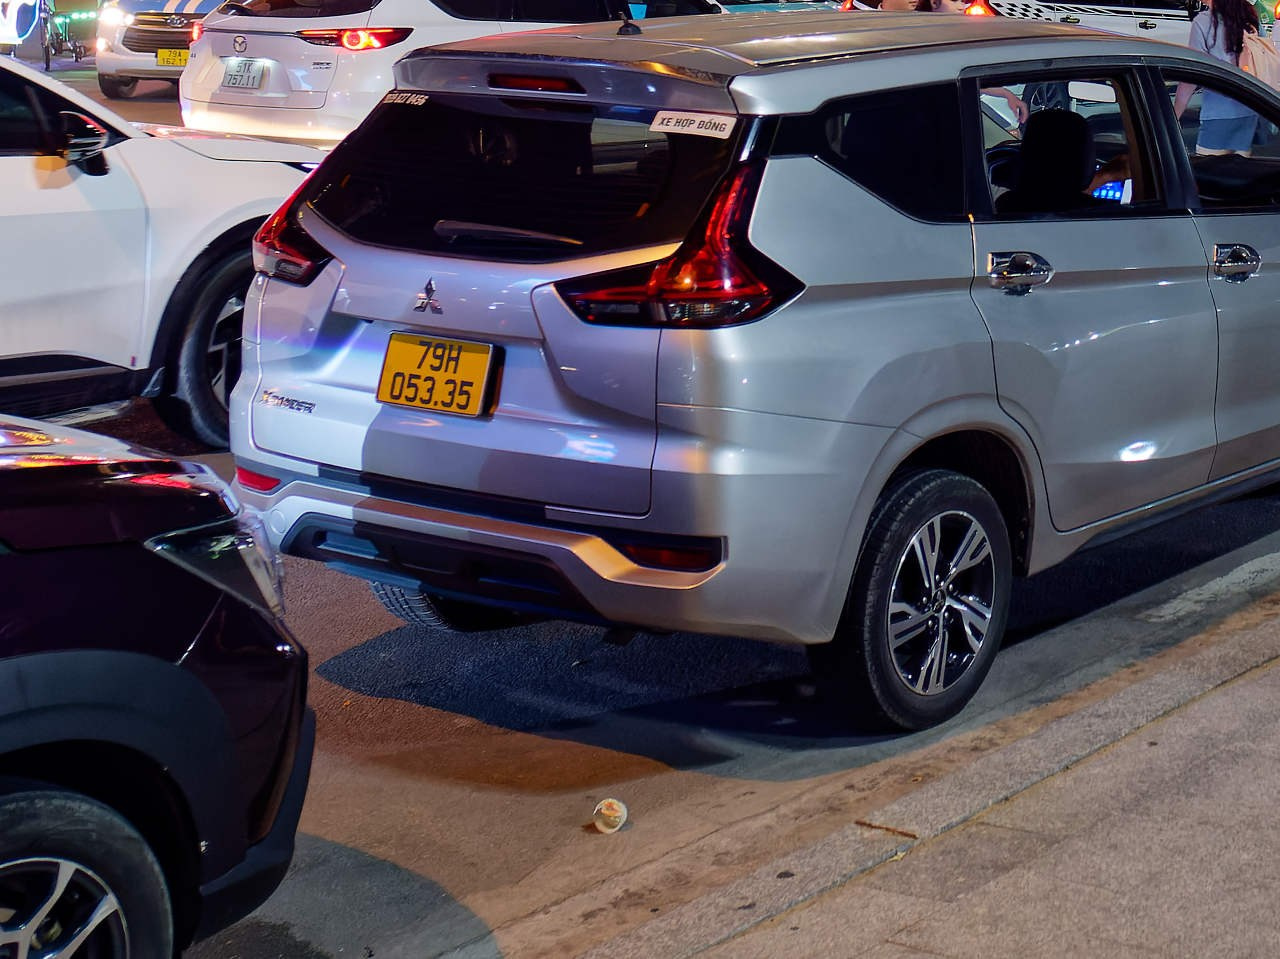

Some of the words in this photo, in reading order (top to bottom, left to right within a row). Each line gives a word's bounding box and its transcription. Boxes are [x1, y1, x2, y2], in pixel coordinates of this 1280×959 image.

[168, 50, 182, 58] 79A
[236, 62, 253, 74] 51K
[227, 74, 256, 87] 757.11
[658, 117, 672, 127] XE
[673, 117, 695, 130] HỢP
[416, 340, 463, 374] 79H
[390, 372, 474, 411] 053.35
